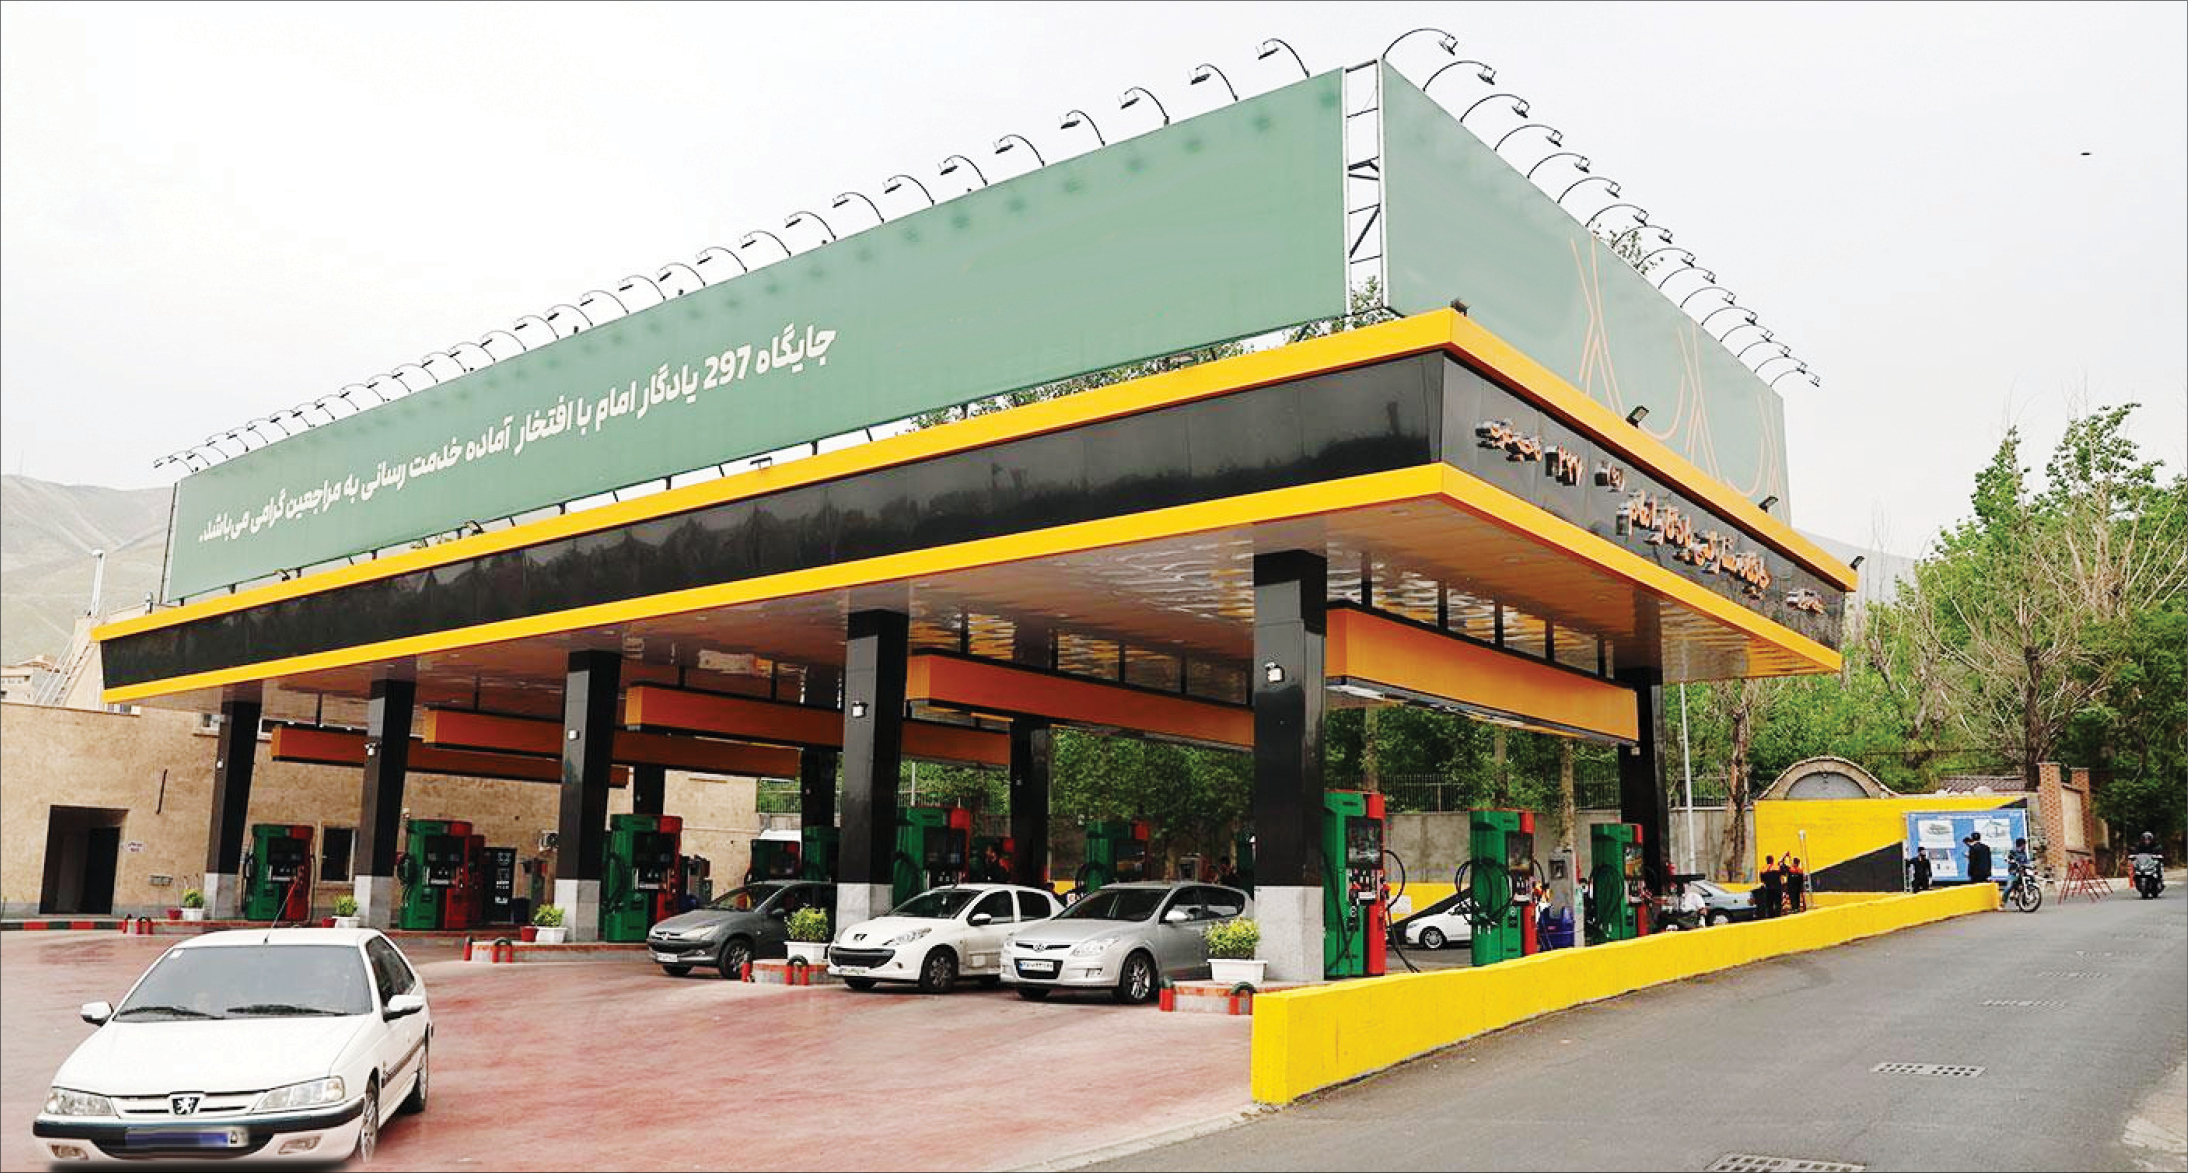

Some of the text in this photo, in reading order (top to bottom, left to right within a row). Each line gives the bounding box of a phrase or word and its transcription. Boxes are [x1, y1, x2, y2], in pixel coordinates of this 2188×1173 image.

[703, 344, 751, 390] 297
[756, 323, 837, 374] جایگاه
[596, 380, 637, 432] امام
[637, 364, 699, 420] یادگار
[465, 415, 514, 462] آماده
[514, 395, 574, 455] افتخار
[577, 398, 592, 436] با
[361, 460, 407, 501] رسانی
[408, 437, 463, 478] خدمت
[250, 488, 287, 534] گرامی
[285, 479, 342, 520] مراجعین
[344, 474, 360, 504] به
